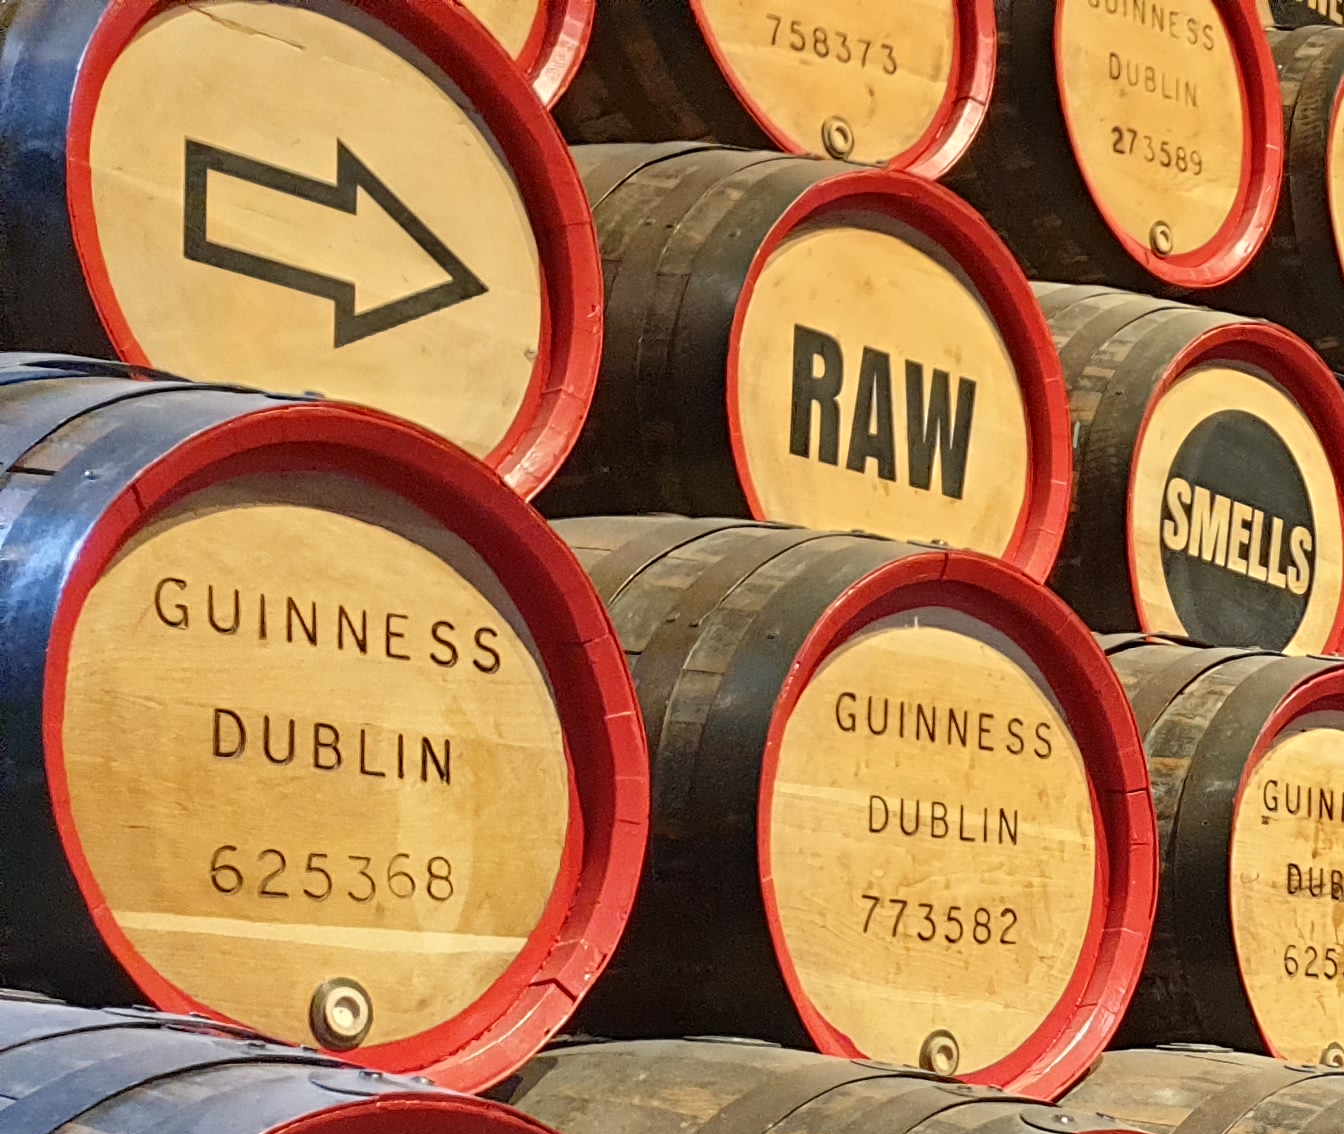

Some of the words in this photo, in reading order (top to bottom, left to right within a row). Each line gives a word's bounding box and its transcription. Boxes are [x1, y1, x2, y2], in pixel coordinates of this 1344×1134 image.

[766, 14, 898, 75] 758373
[1109, 52, 1199, 107] DUBLIN
[1111, 126, 1202, 175] 273589
[788, 323, 977, 500] RAW
[1162, 477, 1315, 596] SMELLS
[154, 577, 501, 673] GUINNESS
[212, 708, 451, 784] DUBLIN
[836, 691, 1053, 759] GUINNESS
[869, 795, 1019, 845] DUBLIN
[210, 845, 454, 902] 625368
[861, 895, 1018, 945] 773582
